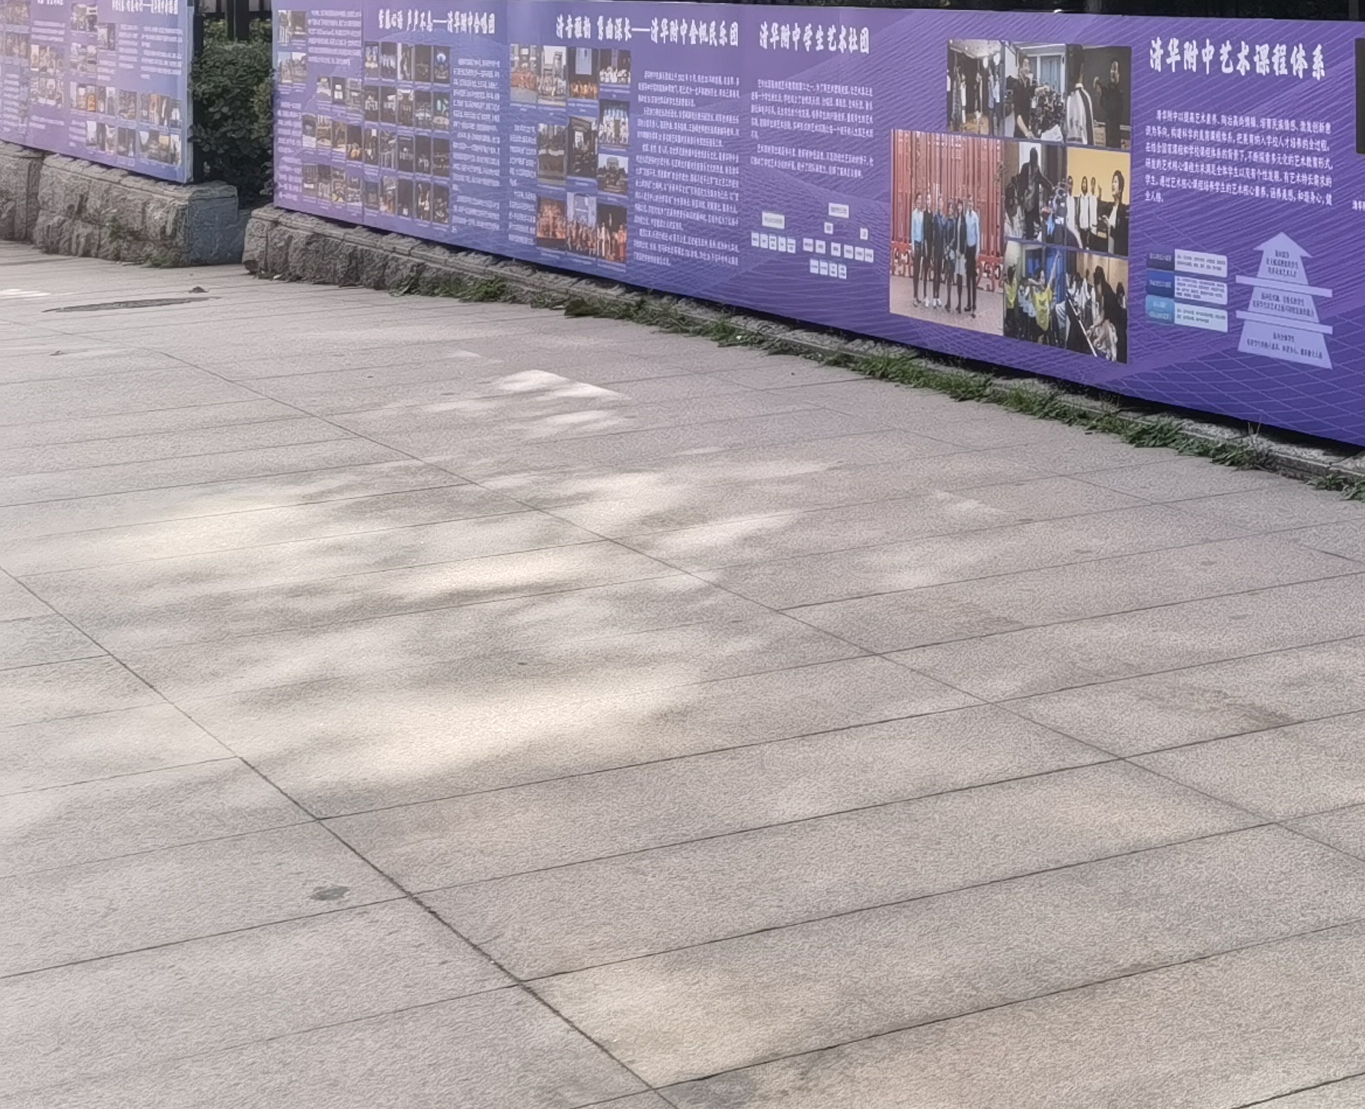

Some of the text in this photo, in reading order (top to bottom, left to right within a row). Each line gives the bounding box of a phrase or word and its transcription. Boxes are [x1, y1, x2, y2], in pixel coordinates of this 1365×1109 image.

[759, 21, 870, 54] 清华附中学生艺术社团
[1150, 37, 1325, 80] 清华附中艺术课程体系
